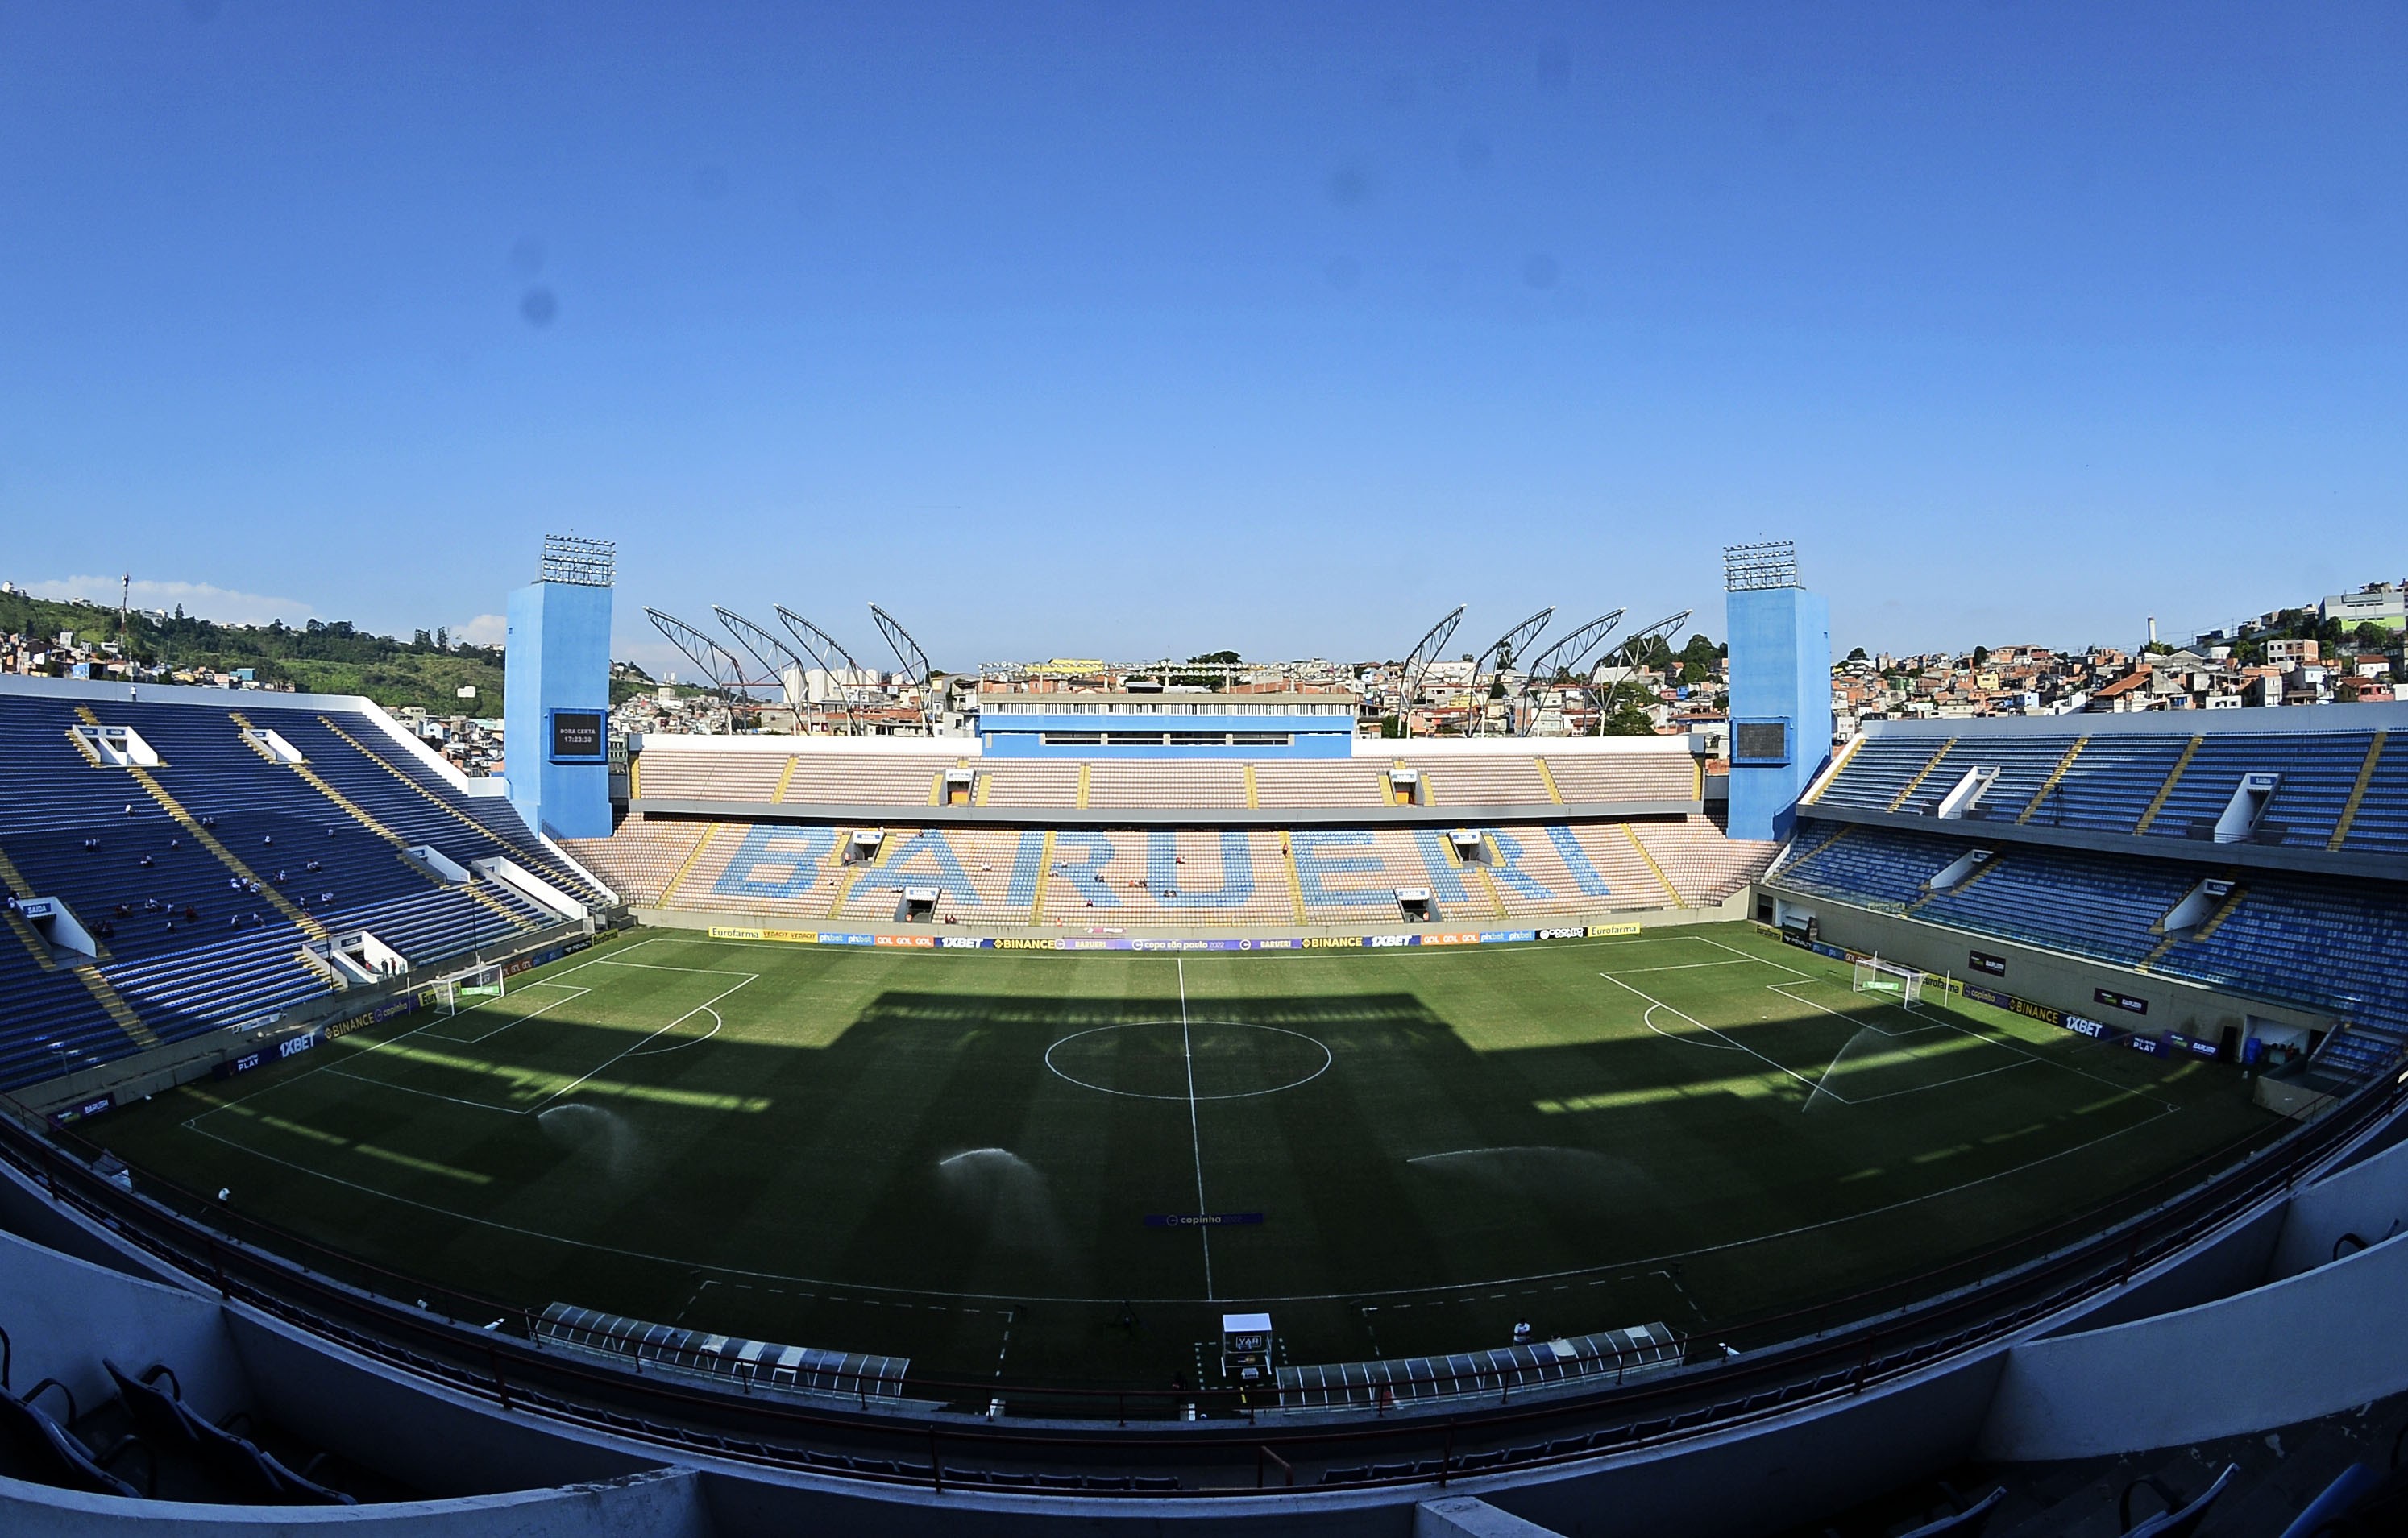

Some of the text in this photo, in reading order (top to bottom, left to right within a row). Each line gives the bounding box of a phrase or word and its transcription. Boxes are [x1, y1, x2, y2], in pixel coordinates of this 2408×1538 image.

[712, 927, 759, 939] Eurofarma
[1480, 931, 1532, 942] pixbet pixbet
[1591, 925, 1637, 937] Eurofarma
[819, 933, 871, 944] pixbet pixbet
[877, 937, 932, 947] GOL GOL GOL
[941, 937, 983, 948] 1XBET
[1003, 939, 1055, 949] BINANCE
[1260, 940, 1291, 948] BARUERI
[1311, 937, 1362, 948] BINANCE
[1371, 935, 1412, 947] 1XBET
[1424, 934, 1477, 943] GOL GOL GOL
[1074, 941, 1106, 949] BARUERI
[1144, 942, 1165, 950] copa
[1183, 940, 1208, 951] paulo
[1970, 989, 1995, 1003] copinha
[2016, 1001, 2059, 1024] BINANCE
[331, 1012, 375, 1038] BINANCE
[2066, 1016, 2103, 1038] 1XBET
[279, 1032, 316, 1058] 1XBET
[2133, 1042, 2155, 1054] PLAY
[238, 1058, 259, 1072] PLAY
[1181, 1215, 1222, 1225] copinha
